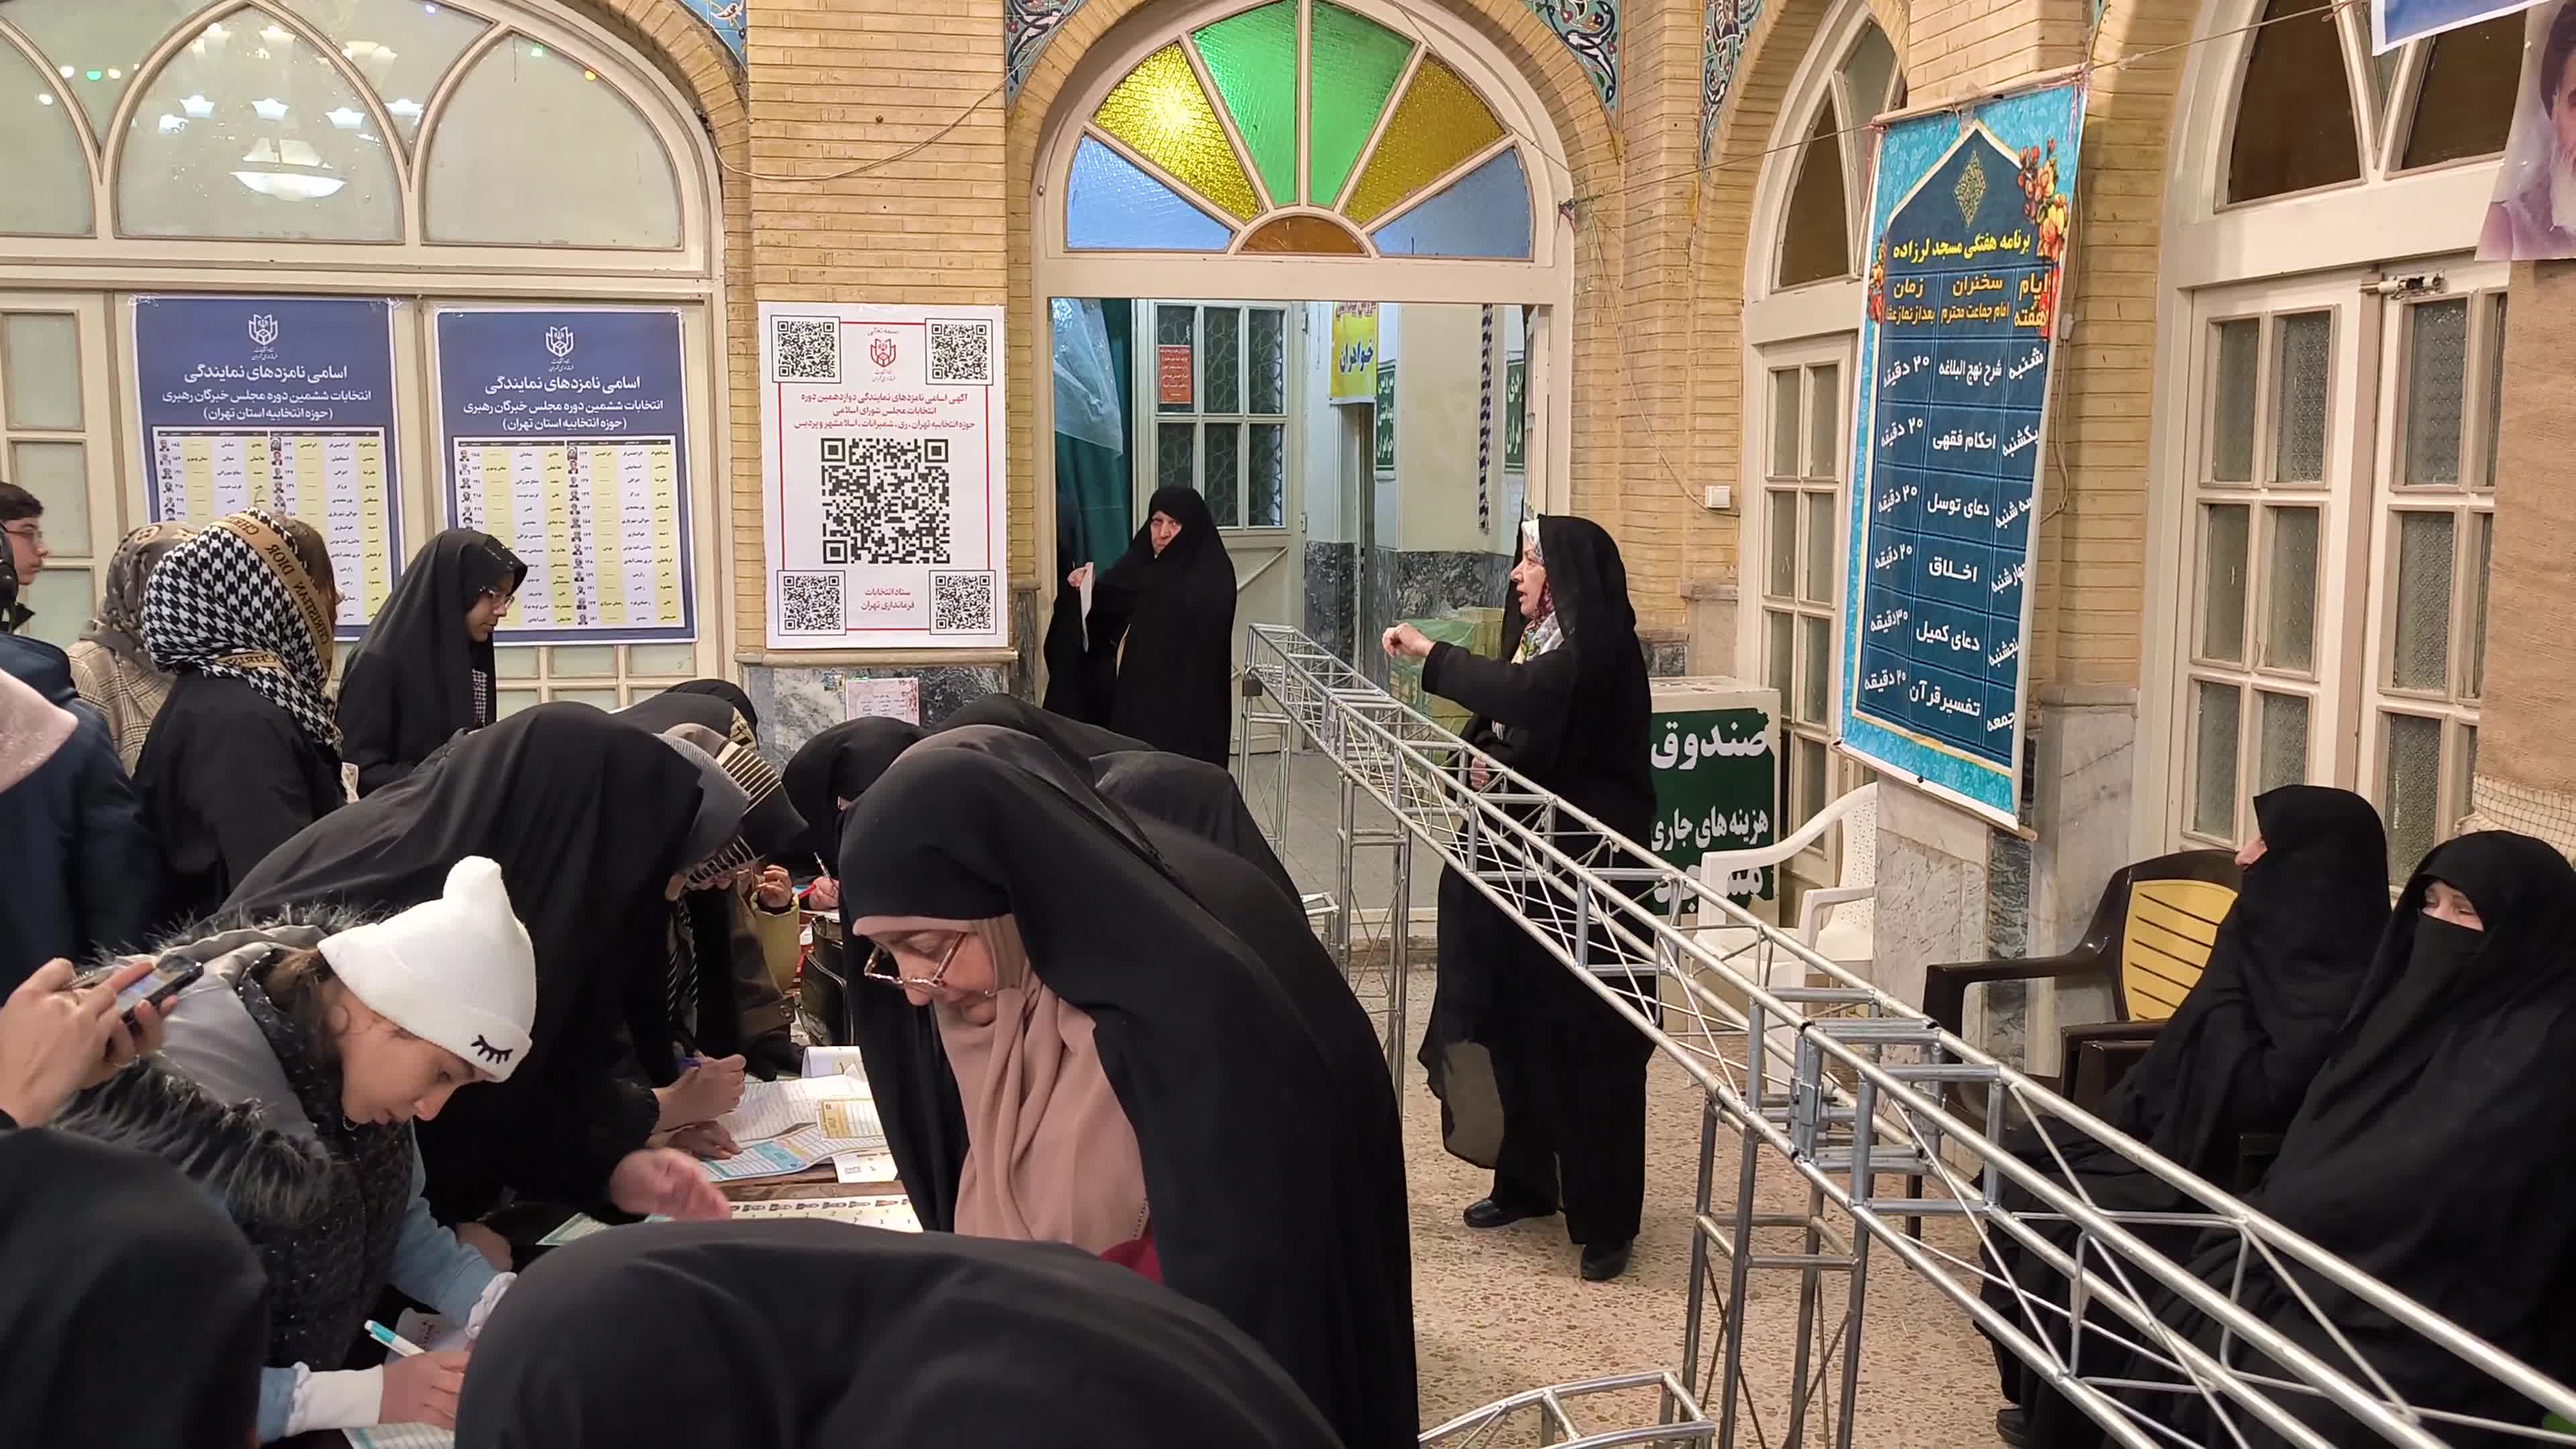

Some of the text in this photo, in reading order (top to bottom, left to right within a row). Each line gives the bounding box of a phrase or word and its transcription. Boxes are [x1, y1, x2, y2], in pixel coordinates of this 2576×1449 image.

[1893, 229, 2031, 263] برنامه هفتگی مسجد لرزاده
[1893, 278, 1924, 299] زمان
[1952, 273, 2003, 297] سخنران
[2018, 273, 2049, 301] ایام
[1940, 301, 2010, 324] امام جماعت محترم
[2014, 306, 2048, 327] هفته
[184, 363, 347, 384] اسامی نامزدهای نمایندگی
[1939, 359, 2002, 386] شرح نهج البلاغه
[2008, 347, 2044, 380] شنبه
[162, 388, 372, 403] انتخابات ششمین دوره مجلس خبرگان رهبری
[485, 376, 641, 394] اسامی نامزدهای نمایندگی
[463, 400, 663, 414] انتخابات ششمین دوره مجلس خبرگان رهبری
[801, 394, 816, 402] دوره
[818, 393, 857, 402] دوازدهمین
[857, 392, 891, 403] نمایندگی
[925, 393, 947, 404] اسامی
[949, 393, 967, 405] آگهی
[236, 407, 265, 420] استان
[266, 407, 304, 421] انتخابیه
[833, 407, 936, 416] انتخابات مجلس شورای اسلامی
[534, 418, 561, 430] استان
[563, 417, 599, 430] انتخابیه
[1880, 422, 1905, 447] دقیقه
[1932, 429, 1996, 452] احکام فقهی
[2002, 425, 2039, 458] یکشنبه
[1878, 489, 1900, 513] دقیقه
[1927, 493, 1990, 519] دعای توسل
[1995, 501, 2019, 529] شنبه
[1874, 547, 1898, 570] دقیقه
[1929, 556, 1978, 583] اخلاق
[1991, 563, 2027, 594] هارشنبه
[865, 588, 894, 596] انتخابات
[861, 600, 914, 611] فرمانداری تهران
[1916, 621, 1980, 651] دعای کمیل
[1988, 637, 2019, 668] نجشنبه
[1864, 669, 1894, 692] دقیقه
[1909, 680, 1981, 718] تفسیر قرآن
[1986, 711, 2015, 732] جمعه
[1650, 721, 1768, 770] صندوق
[1650, 805, 1769, 852] هزینه های جاری
